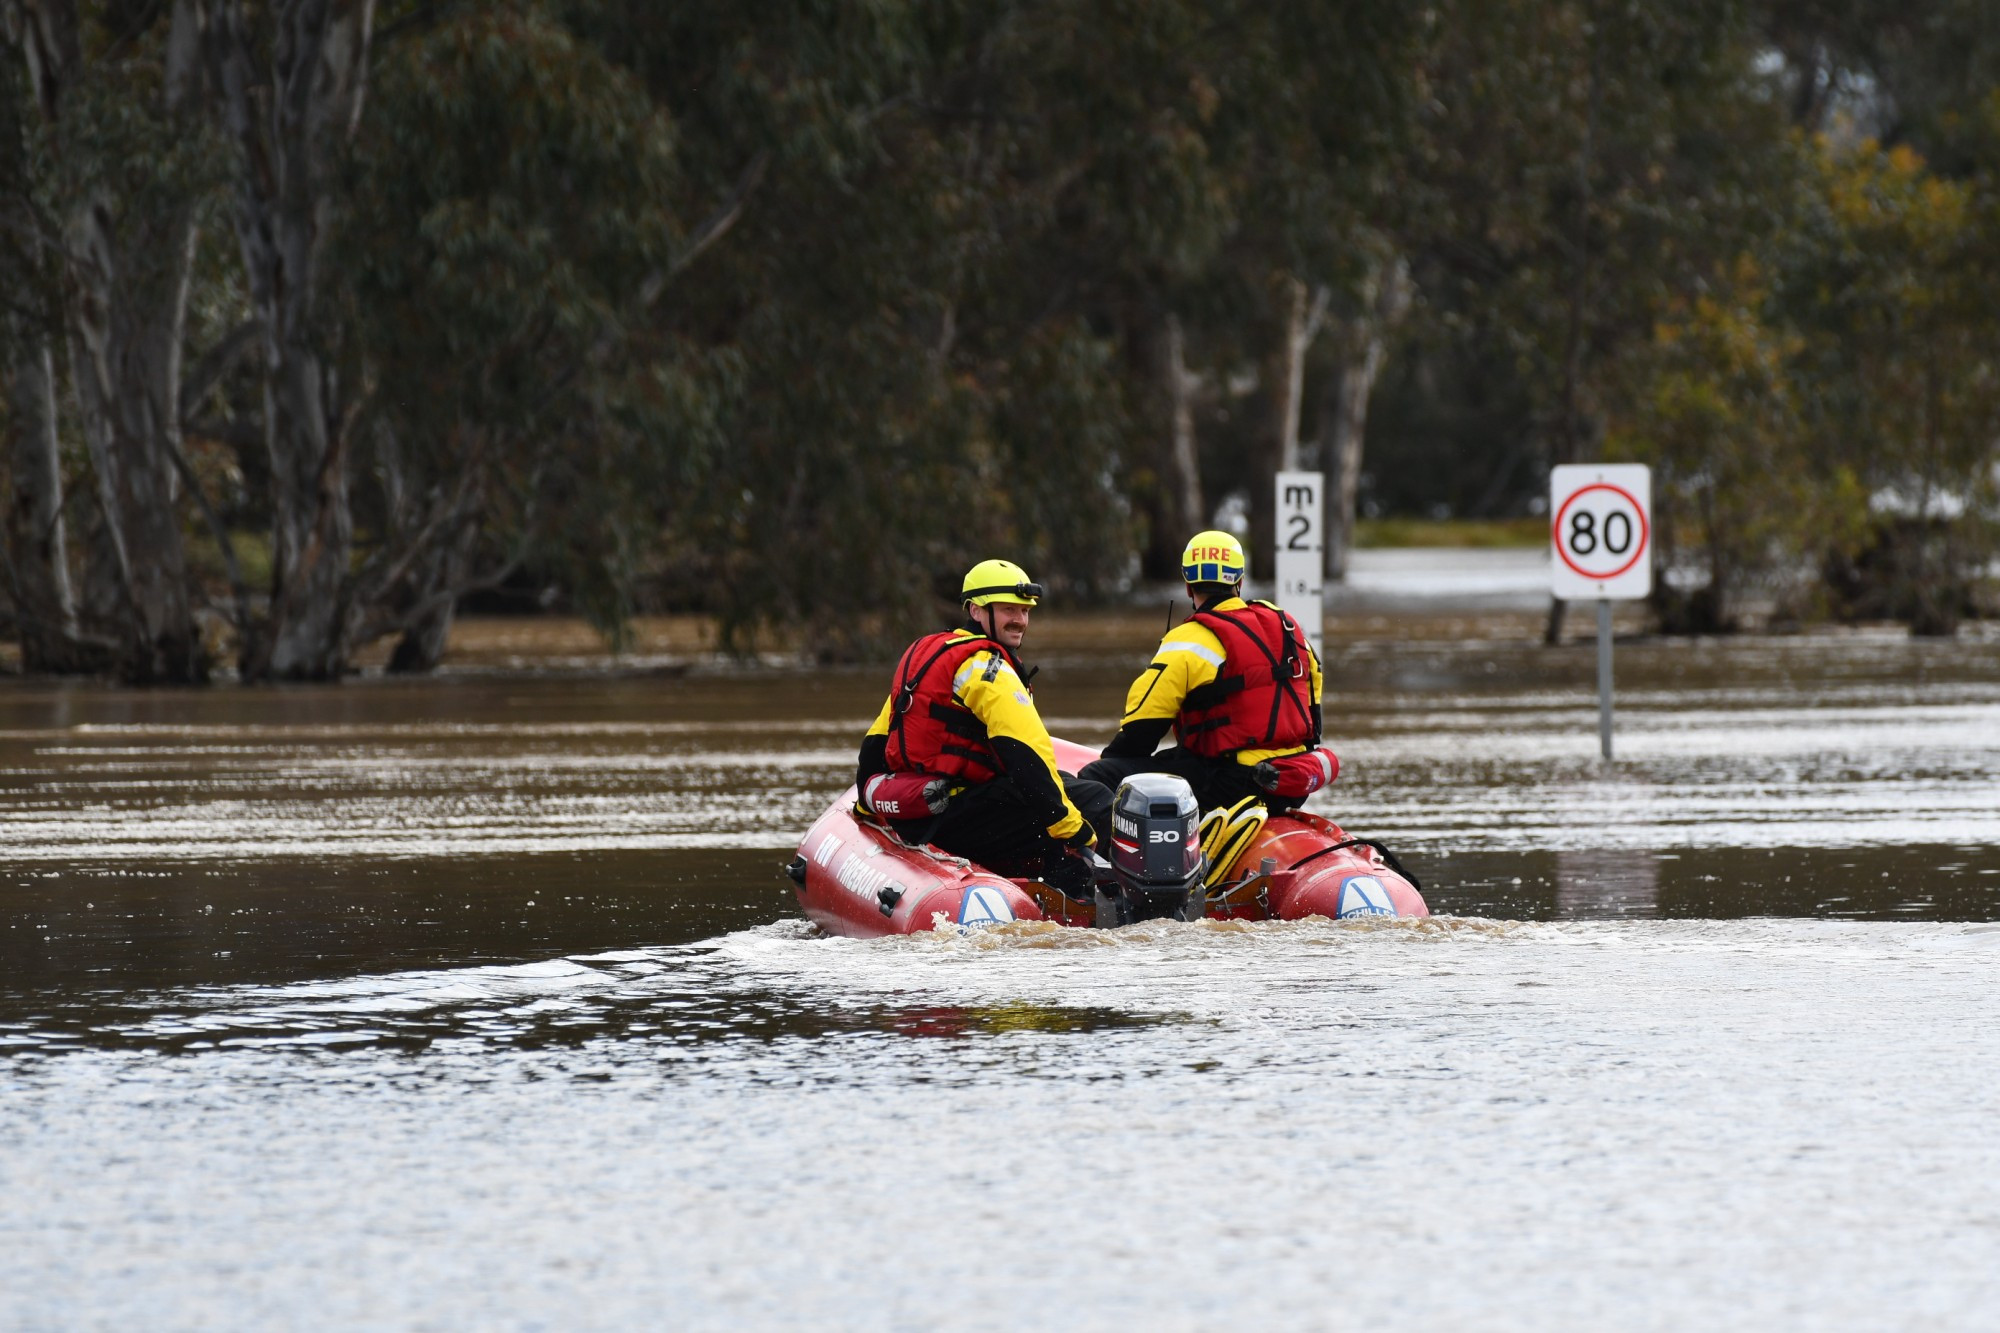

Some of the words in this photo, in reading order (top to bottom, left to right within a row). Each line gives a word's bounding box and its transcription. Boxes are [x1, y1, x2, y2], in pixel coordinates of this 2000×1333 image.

[1288, 515, 1310, 550] 2
[1570, 511, 1632, 554] 80
[1192, 547, 1230, 562] FIRE
[875, 800, 900, 813] FIRE
[1115, 813, 1137, 838] YAMAHA
[1149, 830, 1180, 843] 30
